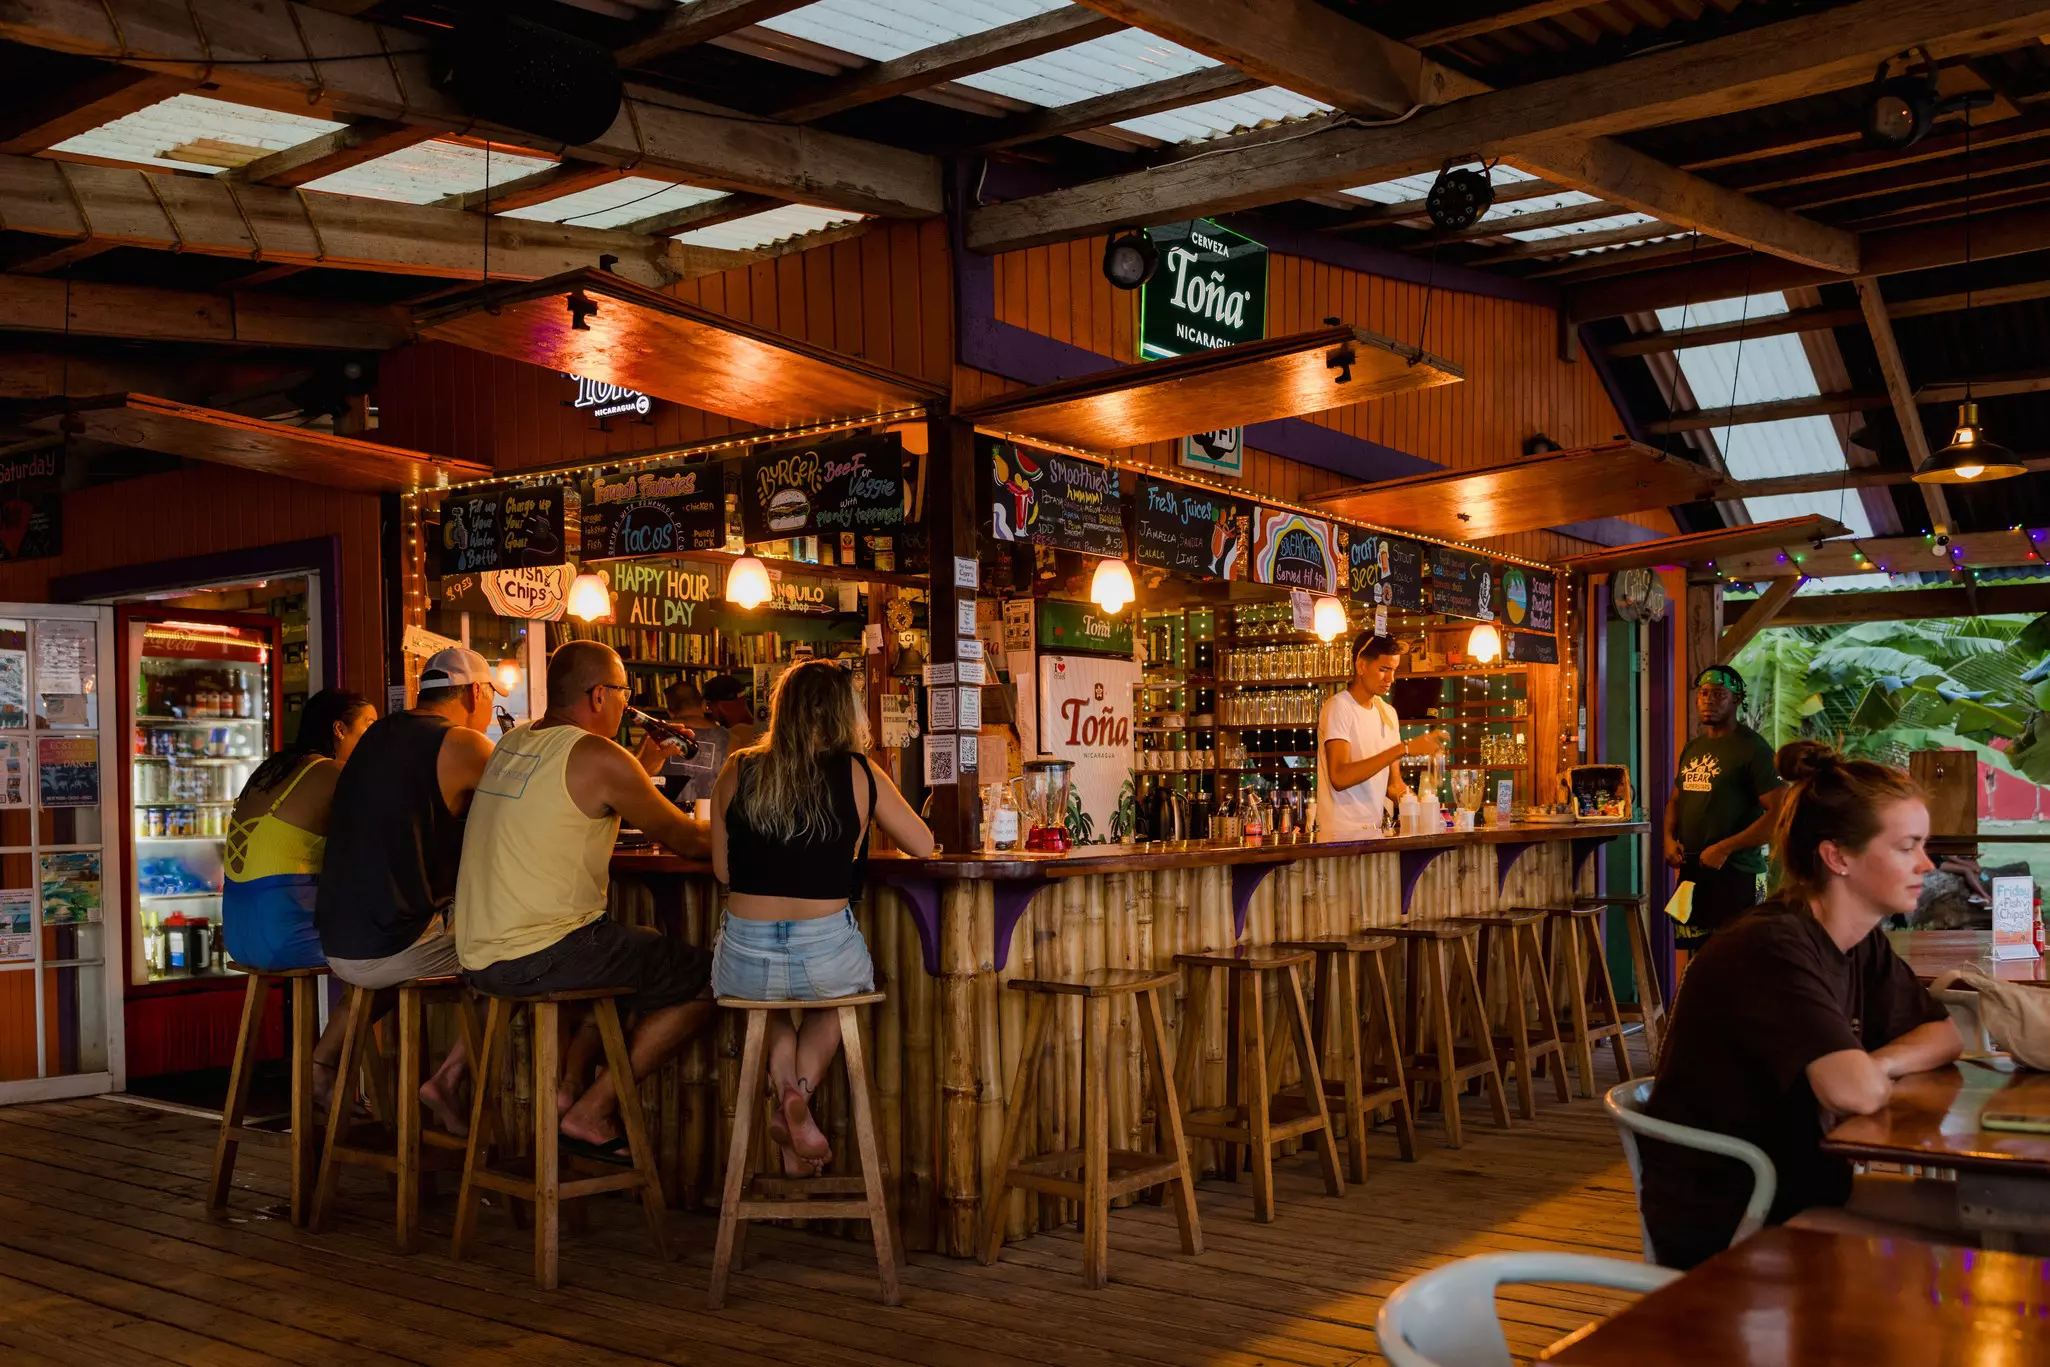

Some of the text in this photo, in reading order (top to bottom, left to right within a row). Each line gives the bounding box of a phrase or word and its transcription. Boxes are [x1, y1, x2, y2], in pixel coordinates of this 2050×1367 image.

[1191, 232, 1230, 258] CERVEZA
[1167, 246, 1244, 329] Toña
[1176, 323, 1236, 349] NICARAGU
[594, 403, 636, 417] NICARAGUA
[0, 449, 55, 483] Saturday
[861, 467, 873, 478] or
[848, 476, 896, 499] Veggie
[469, 499, 497, 518] Fill up
[505, 497, 551, 517] Charge up
[839, 496, 858, 508] with
[1181, 498, 1212, 524] Juices
[621, 514, 673, 554] tacos
[467, 549, 498, 568] Bottle
[544, 579, 551, 587] &
[614, 563, 710, 602] HAPPY HOUR
[1276, 564, 1301, 583] Served
[504, 581, 547, 607] Chips
[630, 597, 696, 628] ALL DAY
[788, 598, 809, 613] Shop
[1061, 697, 1129, 747] Toña
[63, 759, 94, 768] DANCE
[1687, 773, 1709, 783] PEAK
[1996, 884, 2031, 899] Friday
[1999, 908, 2026, 922] Chips
